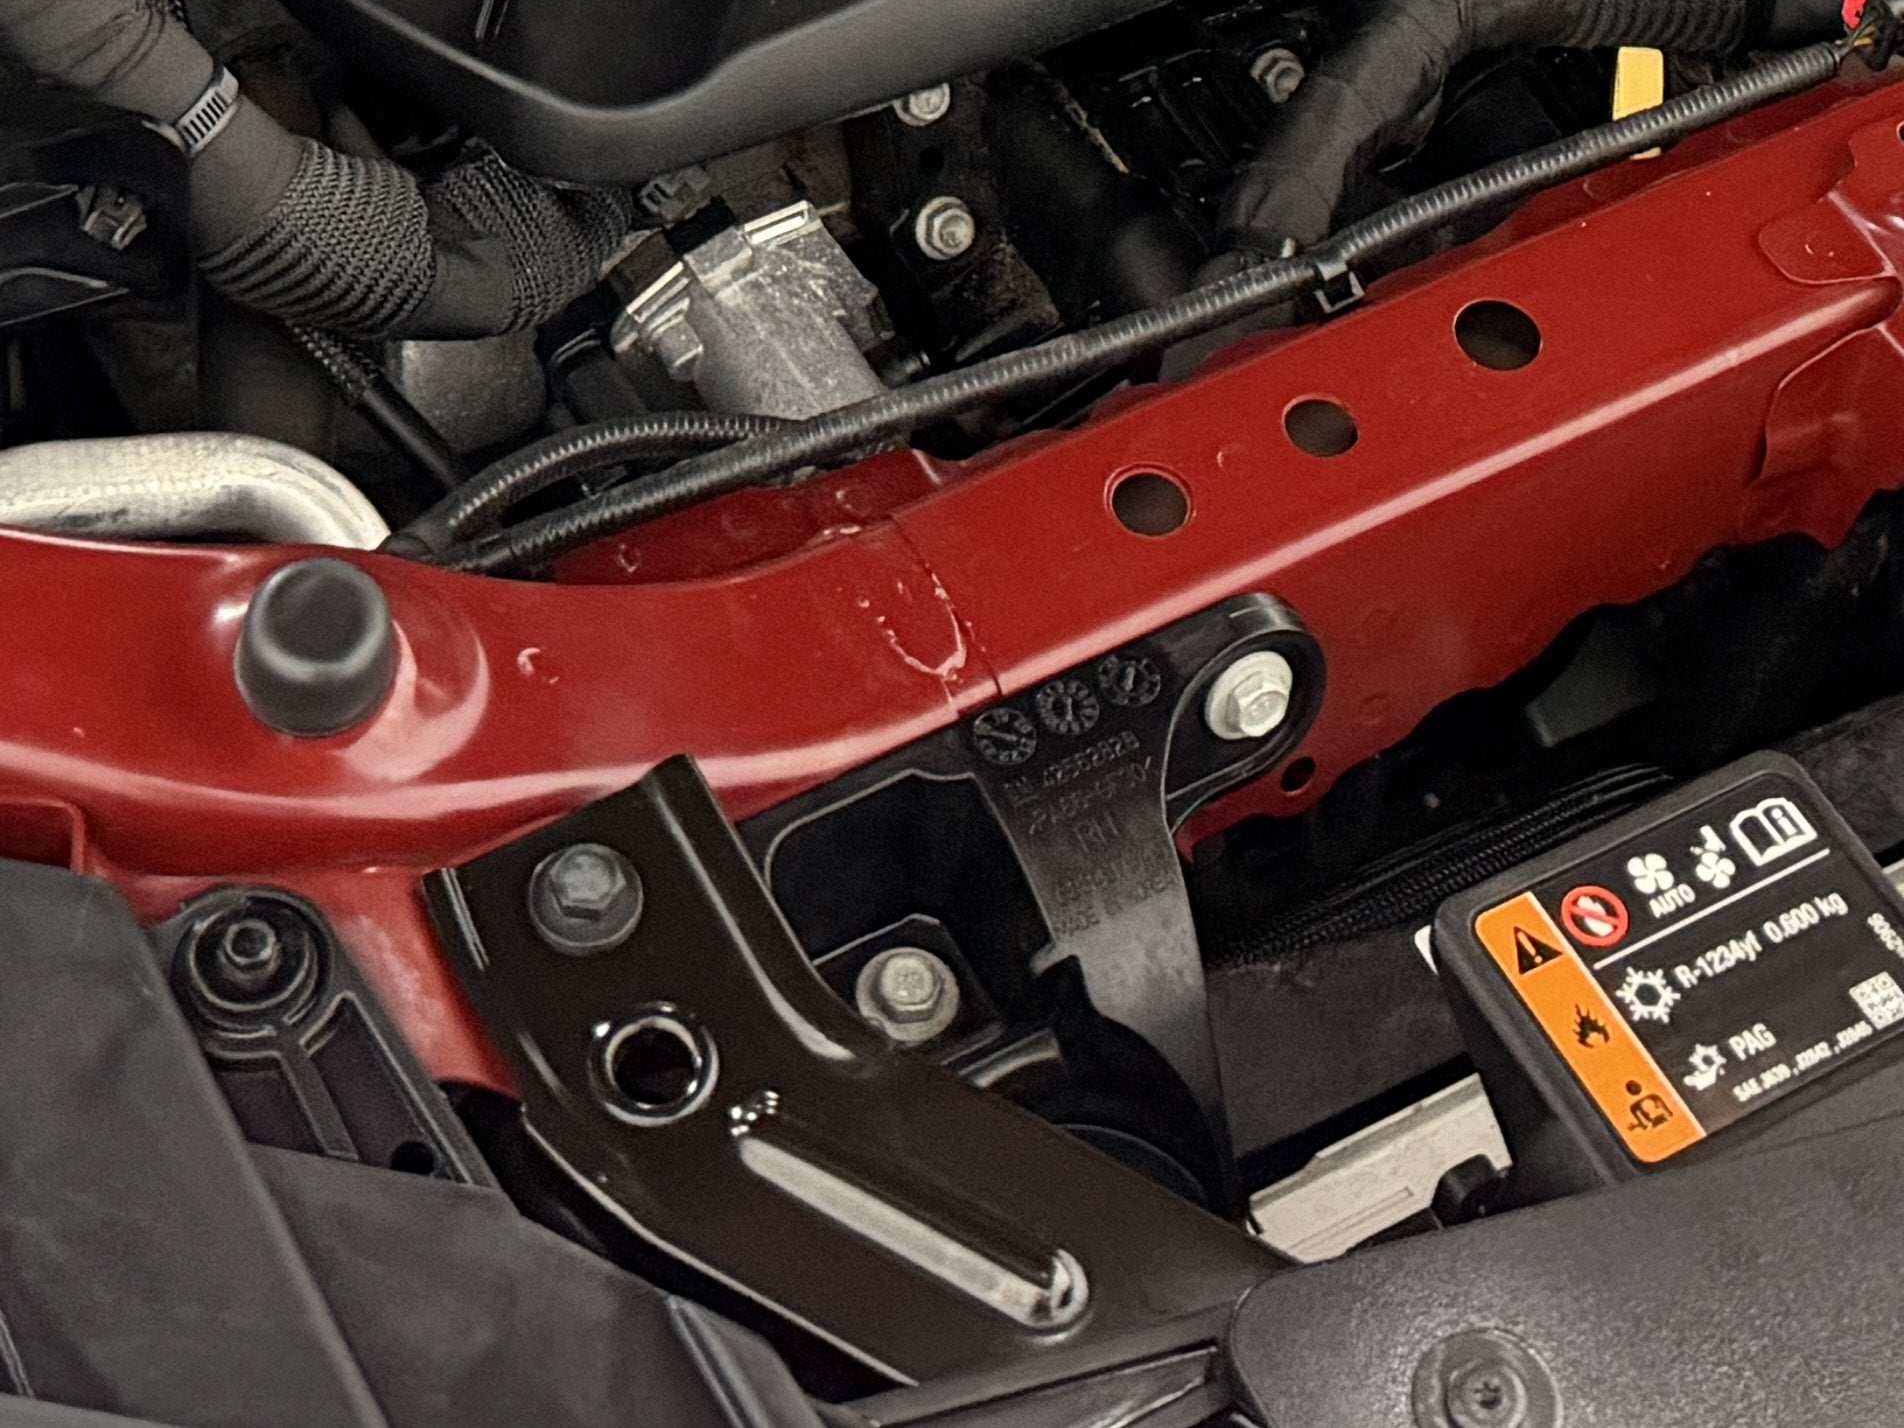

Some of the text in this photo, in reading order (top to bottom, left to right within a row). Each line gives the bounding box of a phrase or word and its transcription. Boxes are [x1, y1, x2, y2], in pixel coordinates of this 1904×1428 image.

[1648, 884, 1696, 918] AUTO
[1675, 890, 1849, 988] R-1234yf 0.600 kg
[1727, 1022, 1776, 1062] PAG
